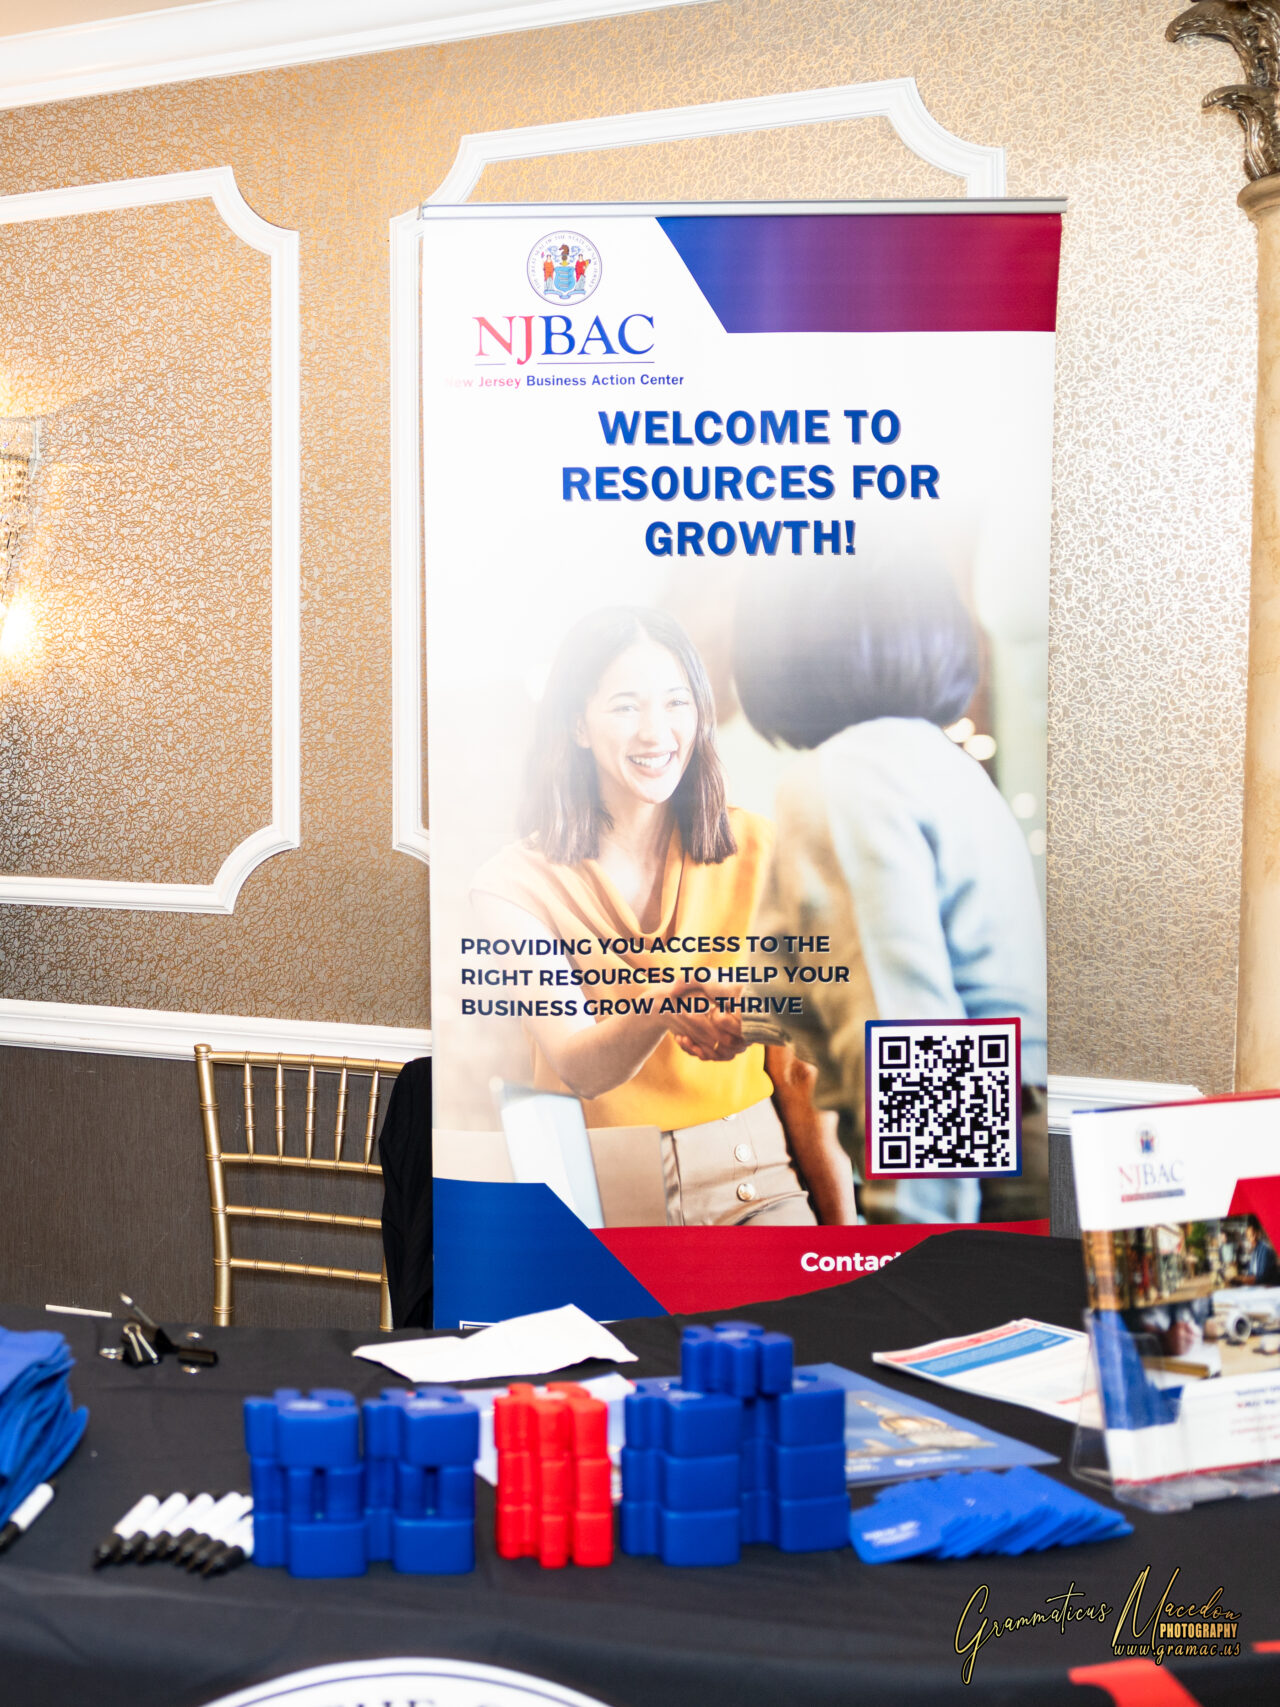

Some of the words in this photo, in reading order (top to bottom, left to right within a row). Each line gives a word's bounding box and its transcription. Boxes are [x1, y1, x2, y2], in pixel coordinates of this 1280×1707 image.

[472, 314, 655, 365] NJBAC
[478, 377, 521, 389] Jersey
[527, 375, 586, 386] Business
[592, 375, 635, 385] Action
[641, 374, 684, 385] Center
[598, 410, 831, 446] WELCOME
[843, 409, 901, 445] TO
[562, 465, 835, 501] RESOURCES
[852, 464, 940, 499] FOR
[645, 520, 857, 557] GROWTH!
[461, 937, 593, 957] PROVIDING
[598, 936, 645, 955] YOU
[650, 935, 741, 955] ACCESS
[746, 935, 779, 953] TO
[784, 934, 830, 953] THE
[461, 968, 533, 987] RIGHT
[539, 967, 675, 987] RESOURCES
[681, 966, 711, 985] TO
[718, 966, 778, 985] HELP
[783, 965, 850, 985] YOUR
[461, 999, 578, 1018] BUSINESS
[583, 998, 655, 1017] GROW
[660, 997, 706, 1016] AND
[712, 997, 804, 1015] THRIVE
[801, 1252, 901, 1272] Contac
